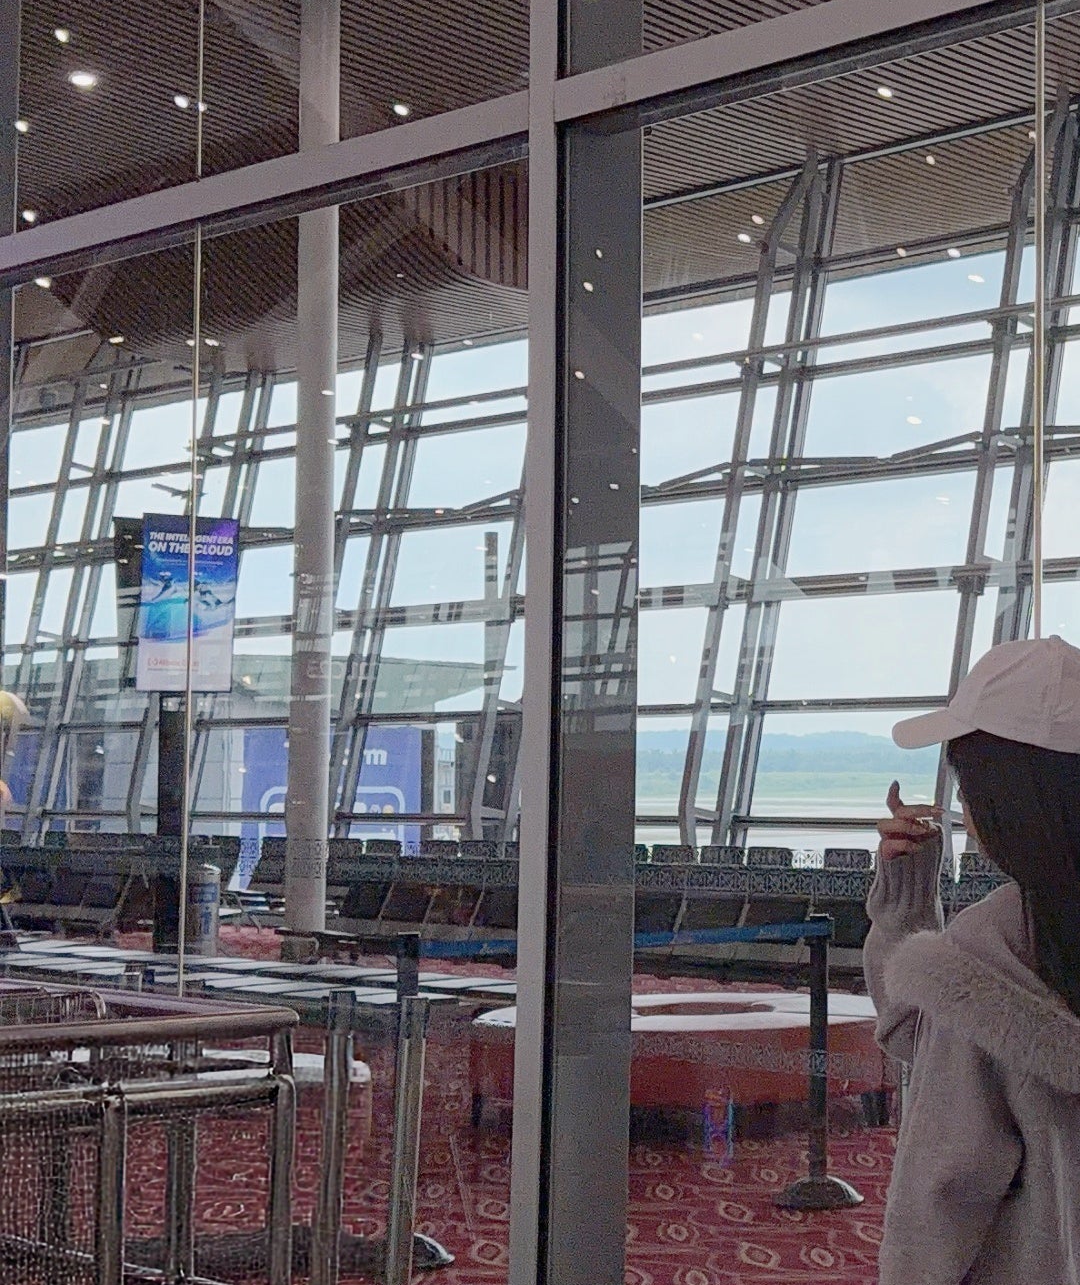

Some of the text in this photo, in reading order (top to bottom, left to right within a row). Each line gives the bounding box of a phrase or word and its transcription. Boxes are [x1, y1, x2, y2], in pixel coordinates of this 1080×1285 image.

[165, 532, 217, 544] INTELGENT
[148, 540, 234, 557] ON THE CLOUD
